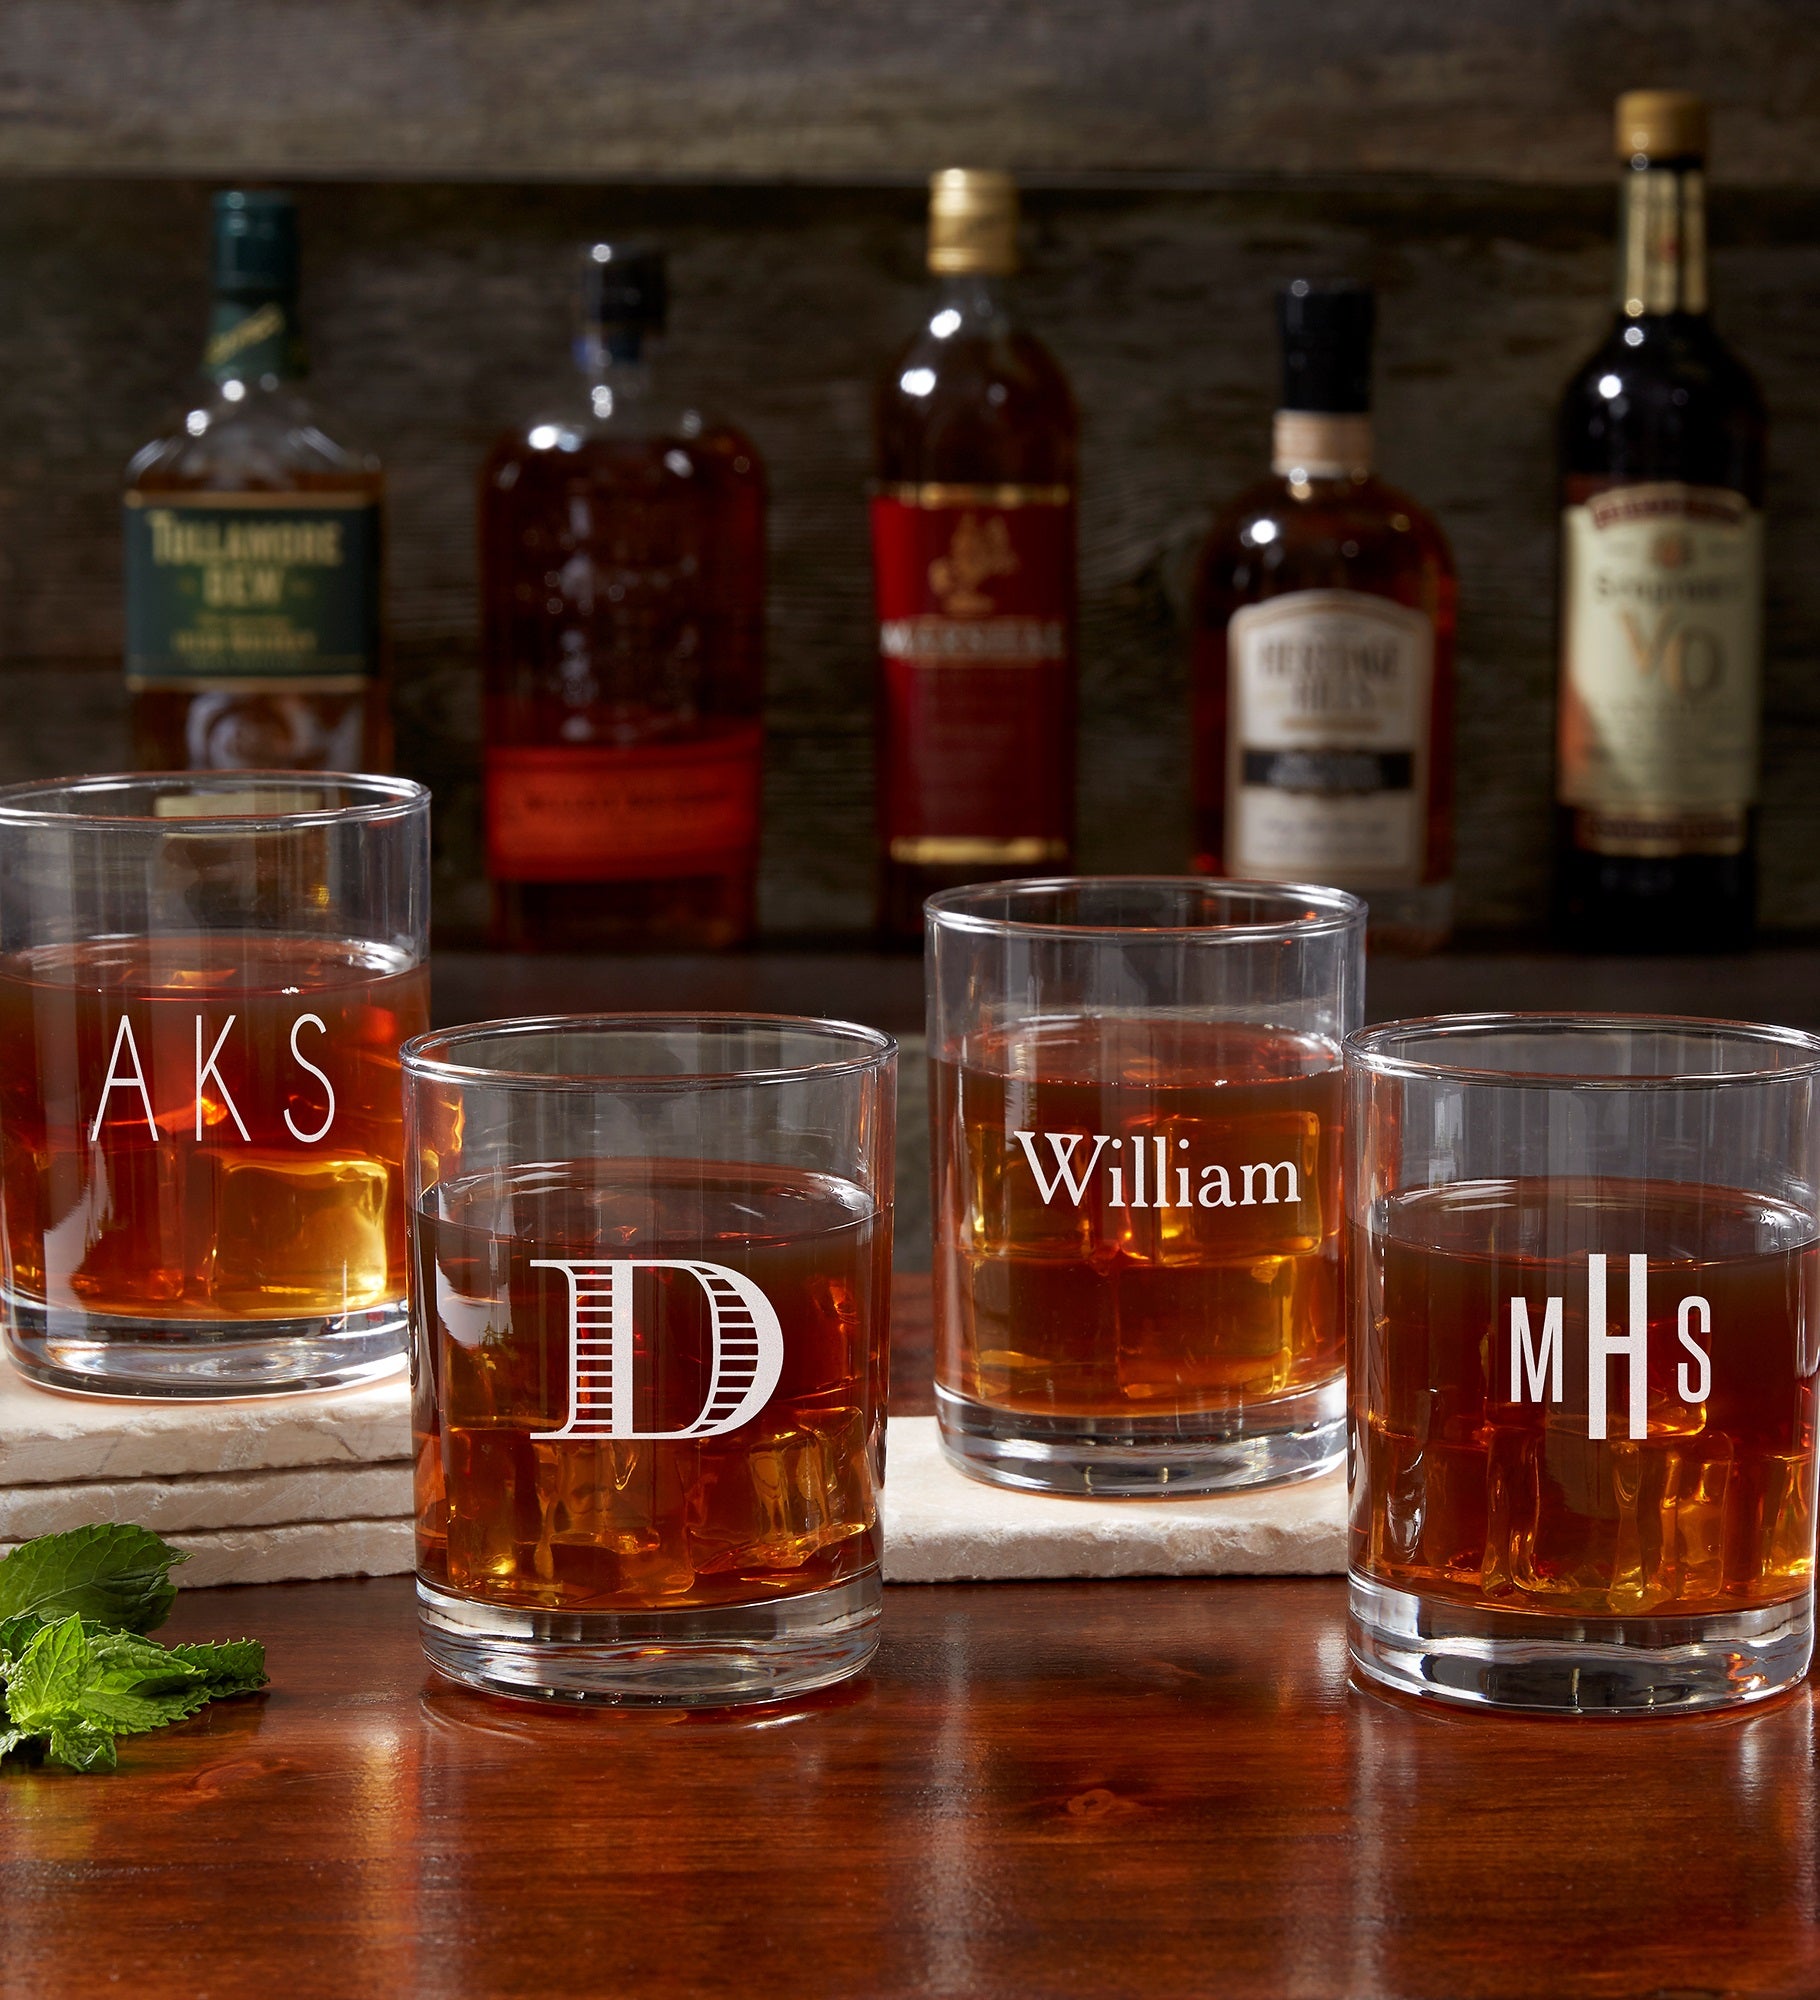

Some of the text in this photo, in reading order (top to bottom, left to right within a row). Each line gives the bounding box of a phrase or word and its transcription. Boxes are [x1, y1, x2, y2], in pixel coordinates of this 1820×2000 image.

[90, 1013, 336, 1143] AKS
[1013, 1130, 1303, 1208] William
[529, 1259, 785, 1441] D
[1510, 1253, 1712, 1441] MHS
